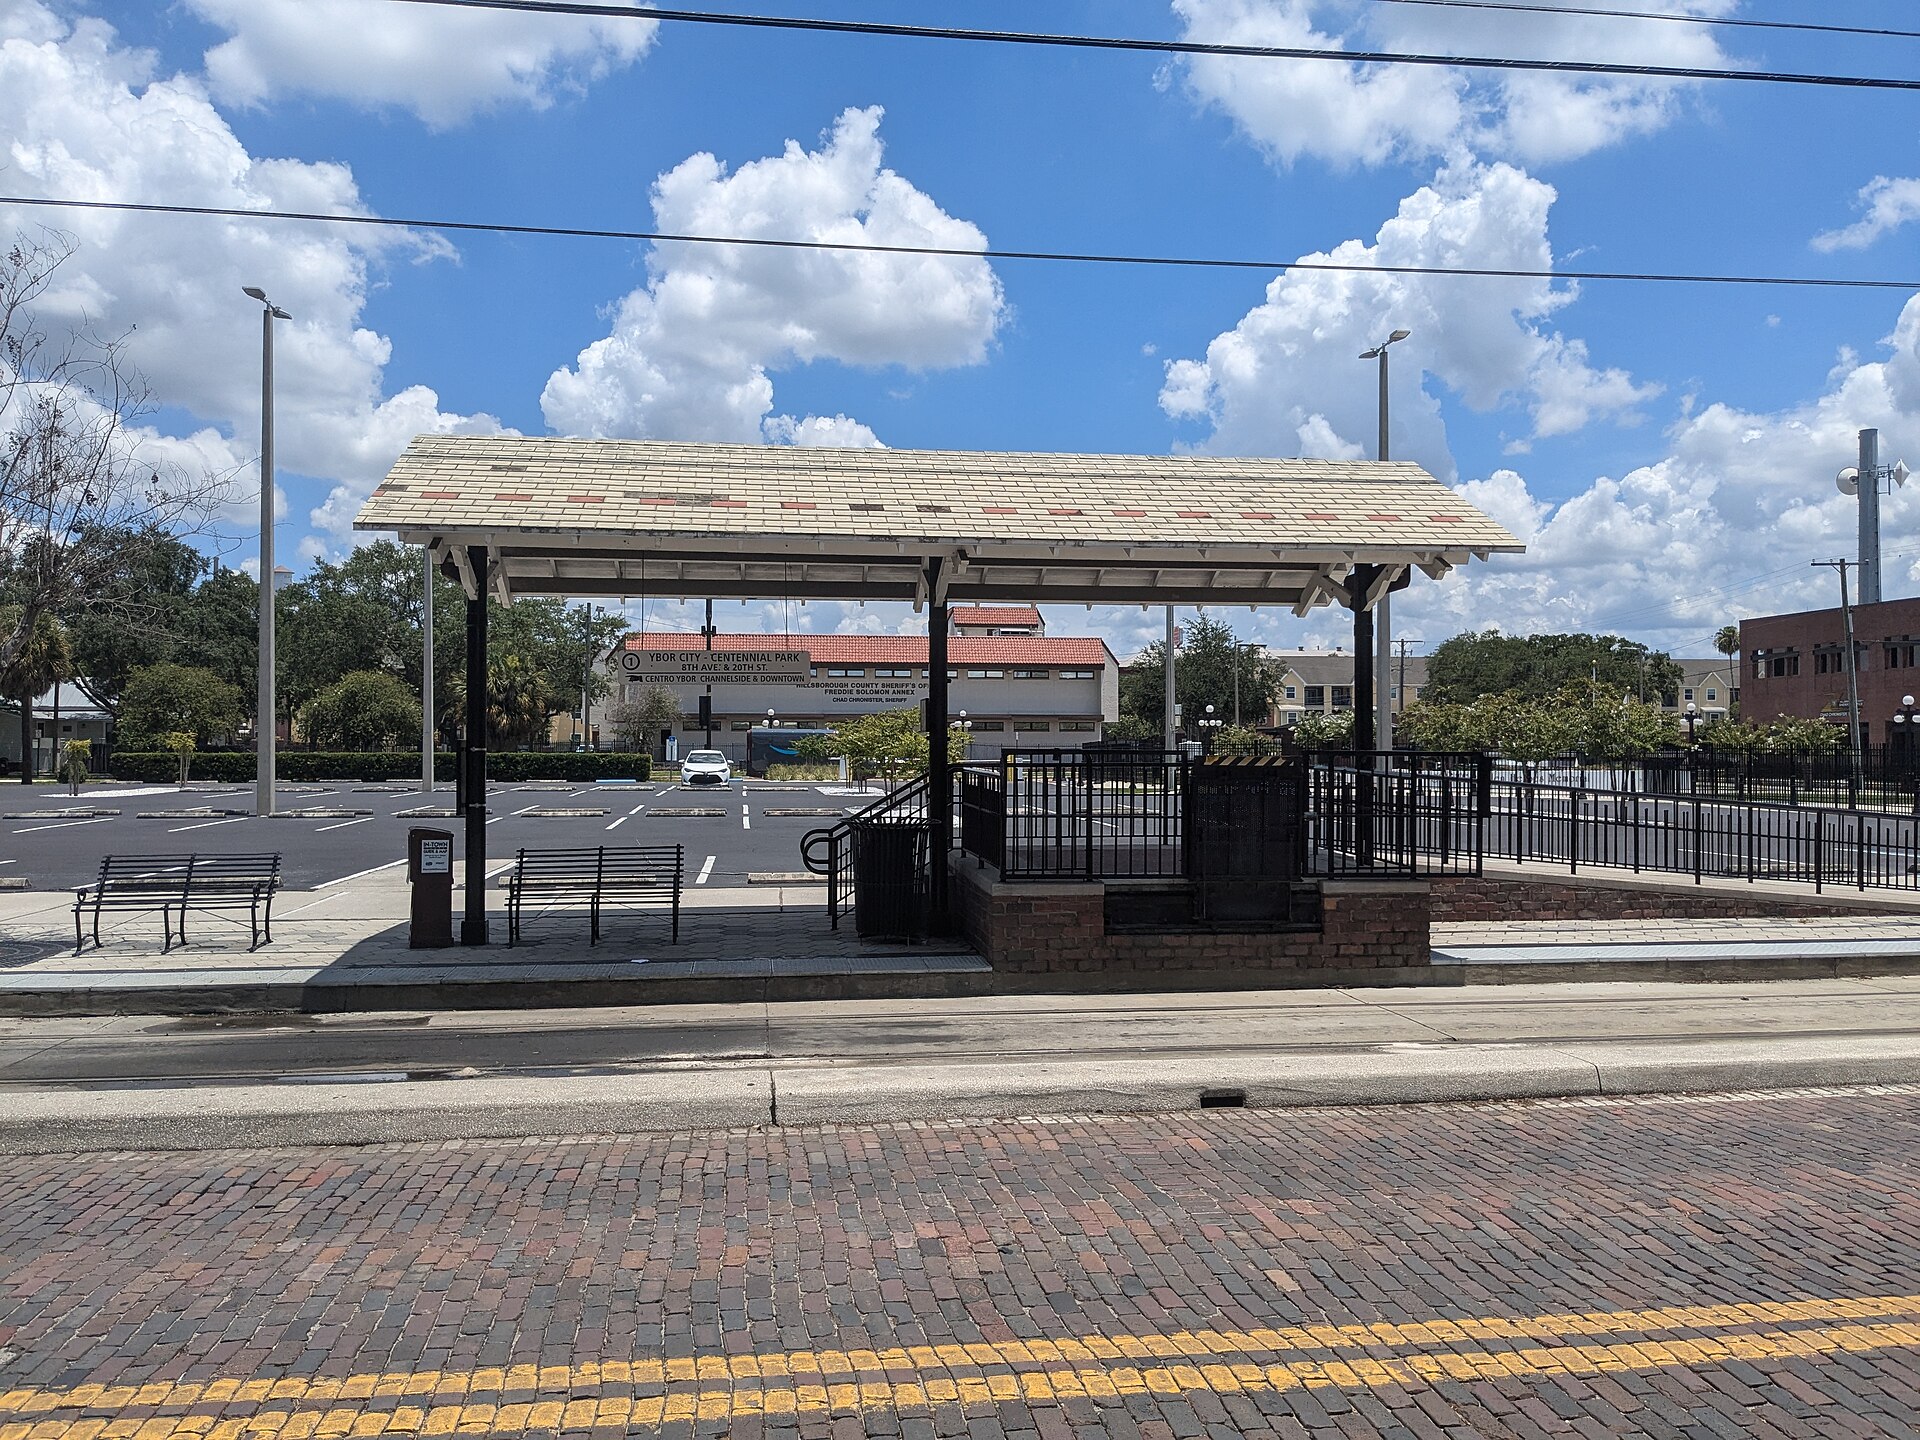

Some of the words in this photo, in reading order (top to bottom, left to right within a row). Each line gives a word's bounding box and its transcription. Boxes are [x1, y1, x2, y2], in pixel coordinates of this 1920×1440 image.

[649, 653, 676, 662] YBOR
[679, 653, 701, 662] CITY
[711, 653, 772, 662] CENTENNIAL
[775, 653, 800, 662] PARK
